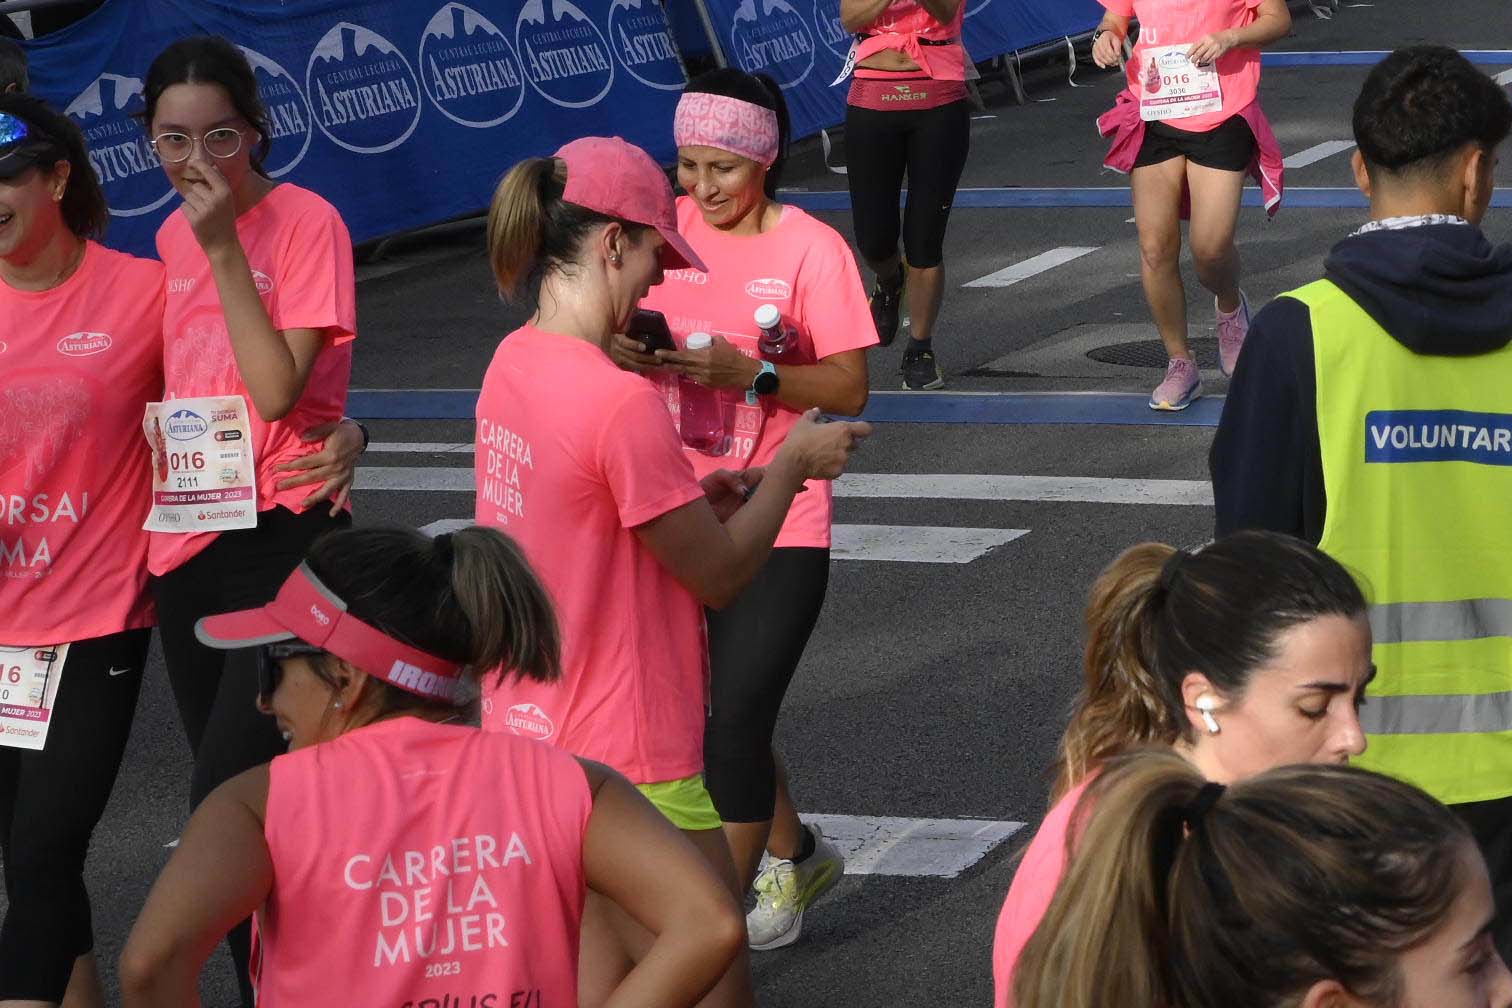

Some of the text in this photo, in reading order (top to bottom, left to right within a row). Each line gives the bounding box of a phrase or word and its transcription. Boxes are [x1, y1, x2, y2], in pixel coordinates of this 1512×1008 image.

[524, 37, 610, 83] ASTURIANA
[429, 52, 521, 102] ASTURIANA
[1163, 74, 1190, 86] 016
[317, 76, 417, 127] ASTURIANA
[881, 91, 928, 102] HANKER
[61, 339, 109, 352] ASTURIANA
[211, 414, 238, 423] SUMA
[169, 423, 203, 433] ASTURIANA
[480, 418, 534, 470] CARRERA
[170, 451, 205, 471] 016
[486, 451, 521, 490] DE LA
[177, 476, 198, 488] 2111
[196, 493, 222, 501] MUJER
[482, 478, 524, 518] MUJER
[207, 509, 246, 520] Santander
[0, 536, 52, 568] MA
[0, 664, 21, 683] 16
[2, 707, 25, 716] MUJER
[6, 725, 40, 737] Santander
[508, 716, 549, 734] ASTURIANA
[344, 831, 532, 890] CARRERA
[380, 874, 498, 928] DE LA
[373, 913, 509, 968] MUJER
[425, 961, 461, 978] 2023
